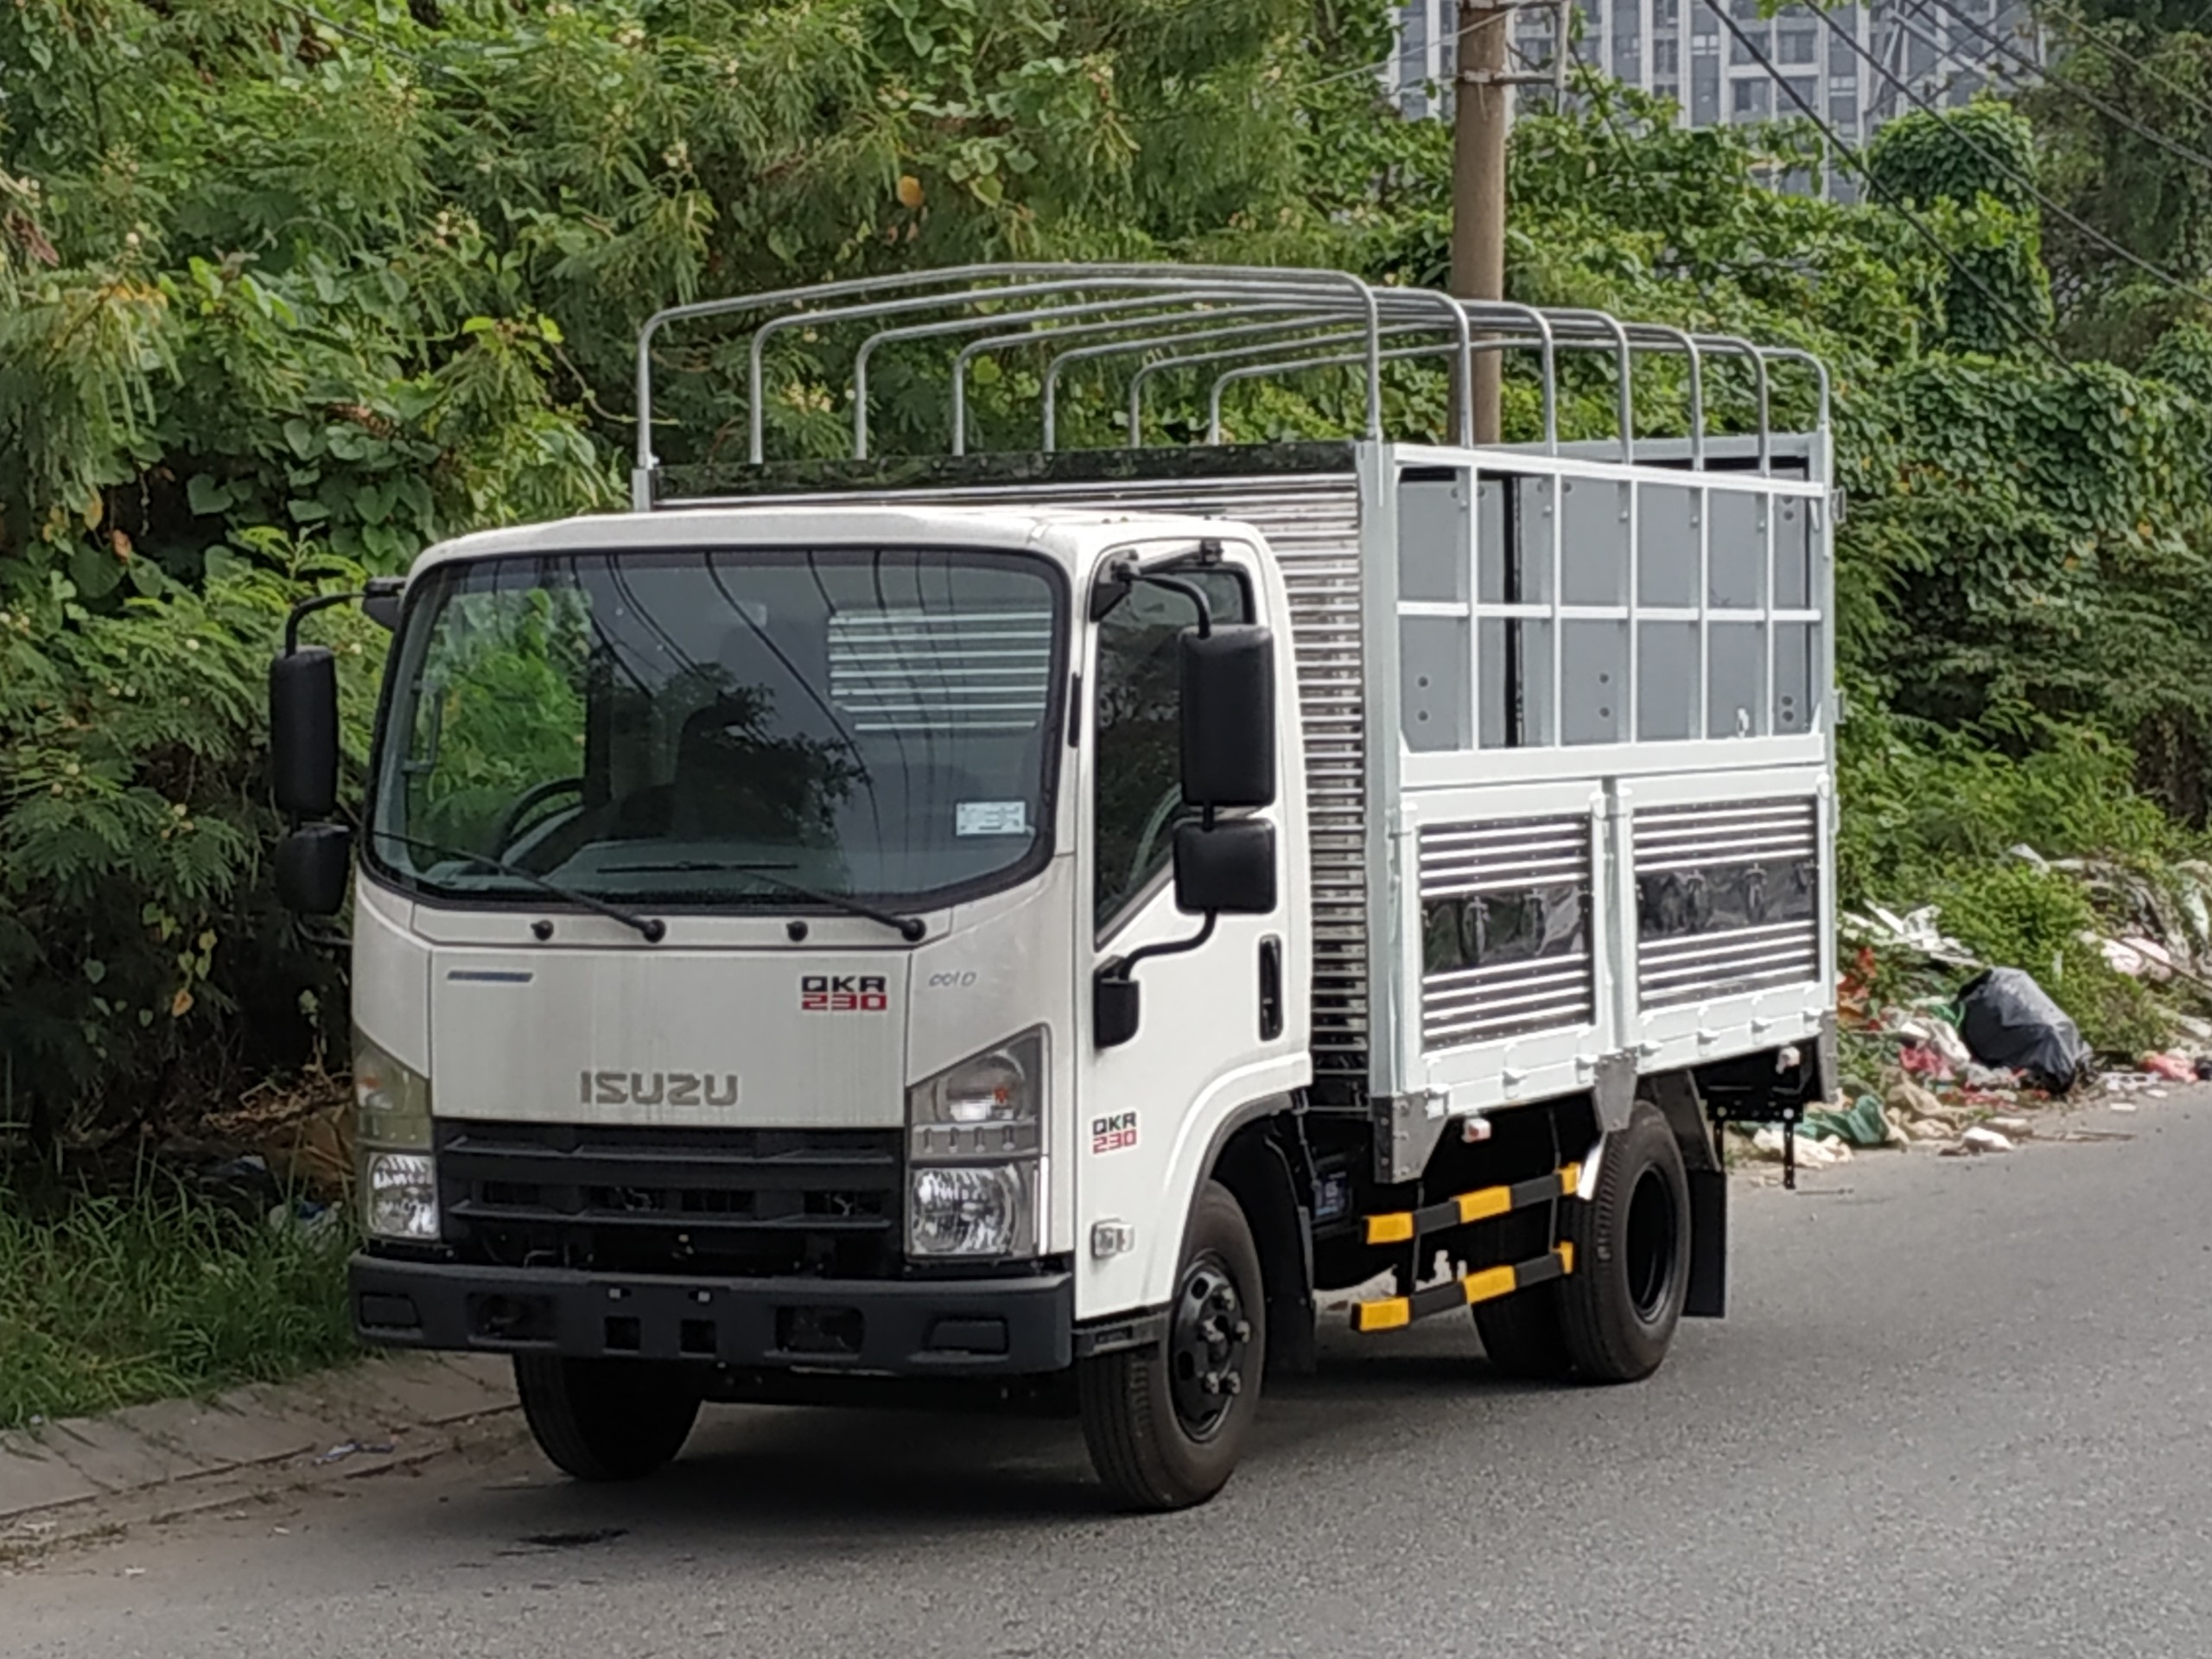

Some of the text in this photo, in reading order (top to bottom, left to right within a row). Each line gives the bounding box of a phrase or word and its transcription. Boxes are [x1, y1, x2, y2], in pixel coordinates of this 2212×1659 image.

[802, 976, 887, 992] QKR
[802, 994, 887, 1010] 230
[582, 1071, 738, 1106] ISUZU
[1093, 1111, 1136, 1135] QKR
[1093, 1129, 1136, 1154] 230
